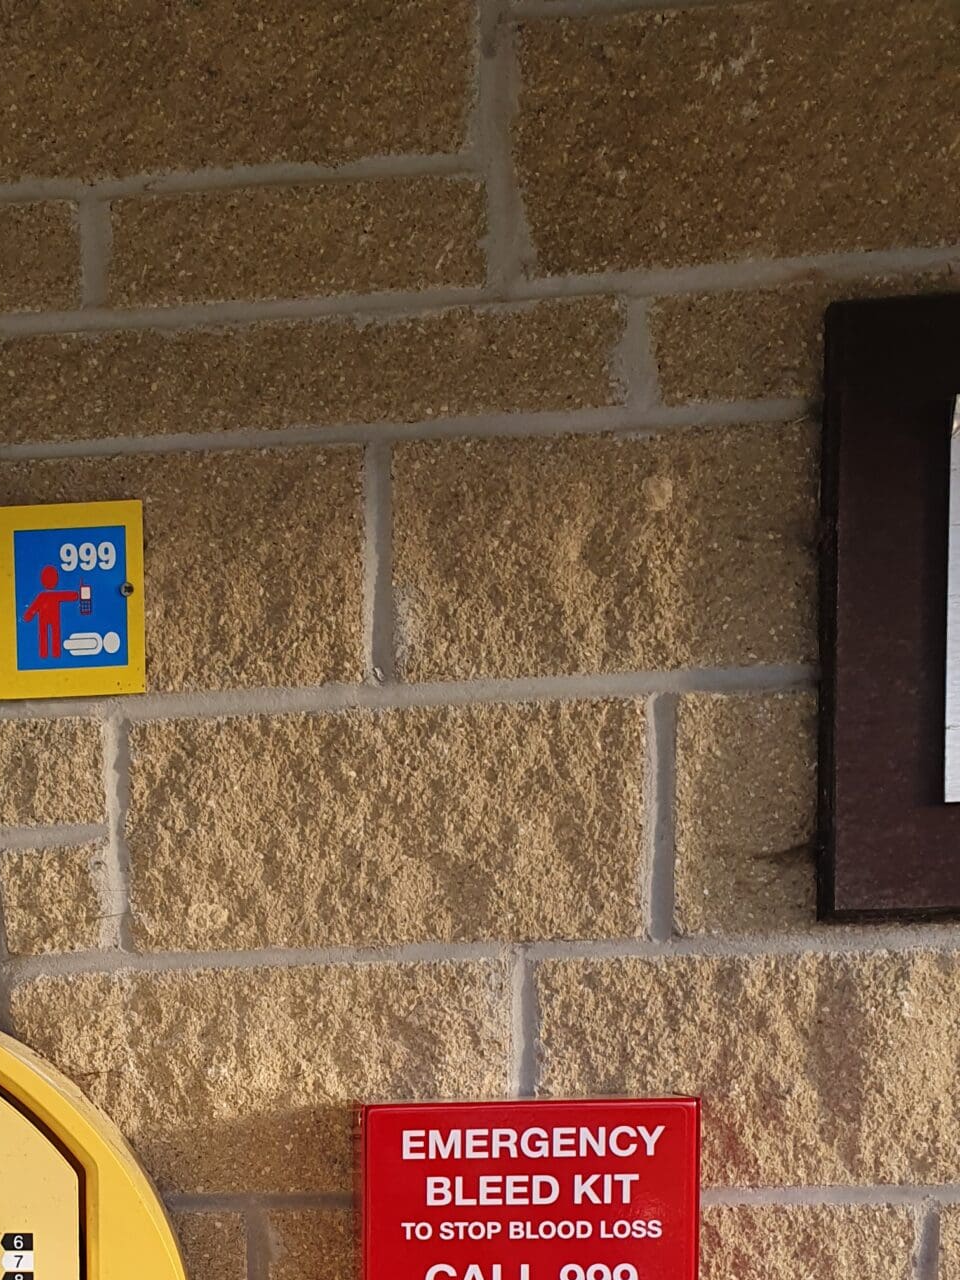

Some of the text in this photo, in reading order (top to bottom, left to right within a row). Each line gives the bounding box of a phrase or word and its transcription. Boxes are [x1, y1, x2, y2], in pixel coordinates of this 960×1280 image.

[58, 540, 117, 573] 999
[401, 1125, 666, 1160] EMERGENCY
[426, 1173, 640, 1206] BLEED KIT
[13, 1235, 24, 1249] 6
[401, 1219, 663, 1240] TO STOP BLOOD LOSS
[13, 1254, 24, 1269] 7
